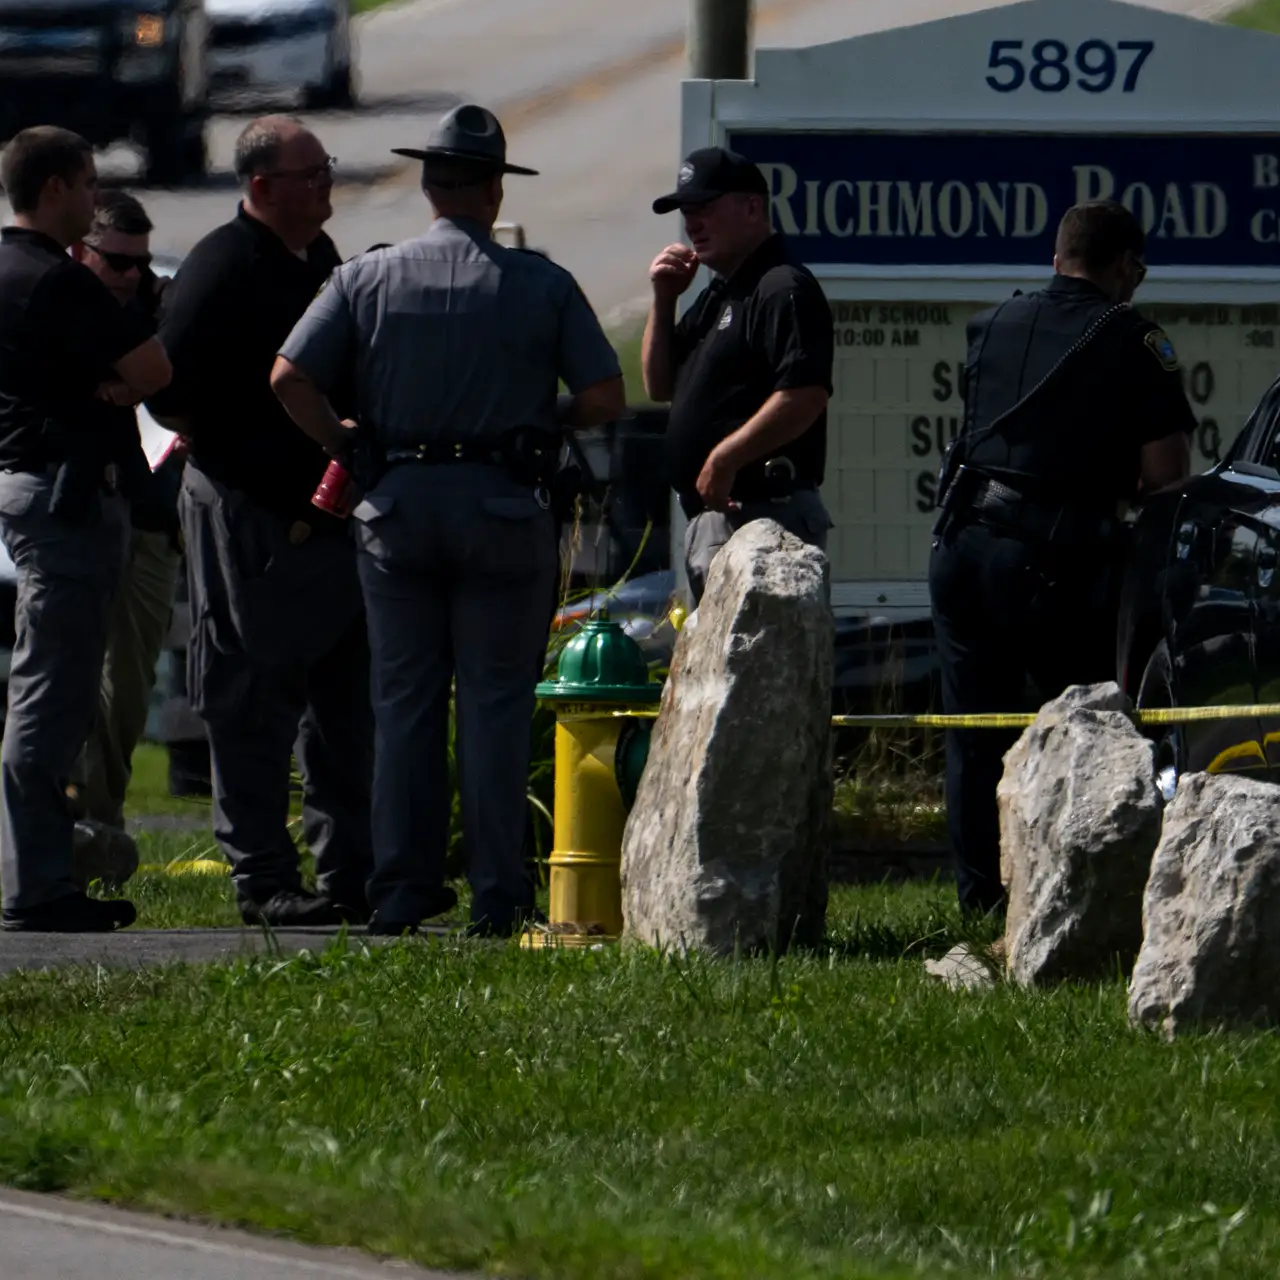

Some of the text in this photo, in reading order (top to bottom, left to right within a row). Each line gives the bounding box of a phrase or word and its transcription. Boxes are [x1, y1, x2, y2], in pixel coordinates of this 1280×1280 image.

[985, 39, 1154, 93] 5897
[755, 162, 1049, 238] RICHMOND
[832, 305, 952, 325] DAY SCHOOL
[891, 328, 920, 347] AM
